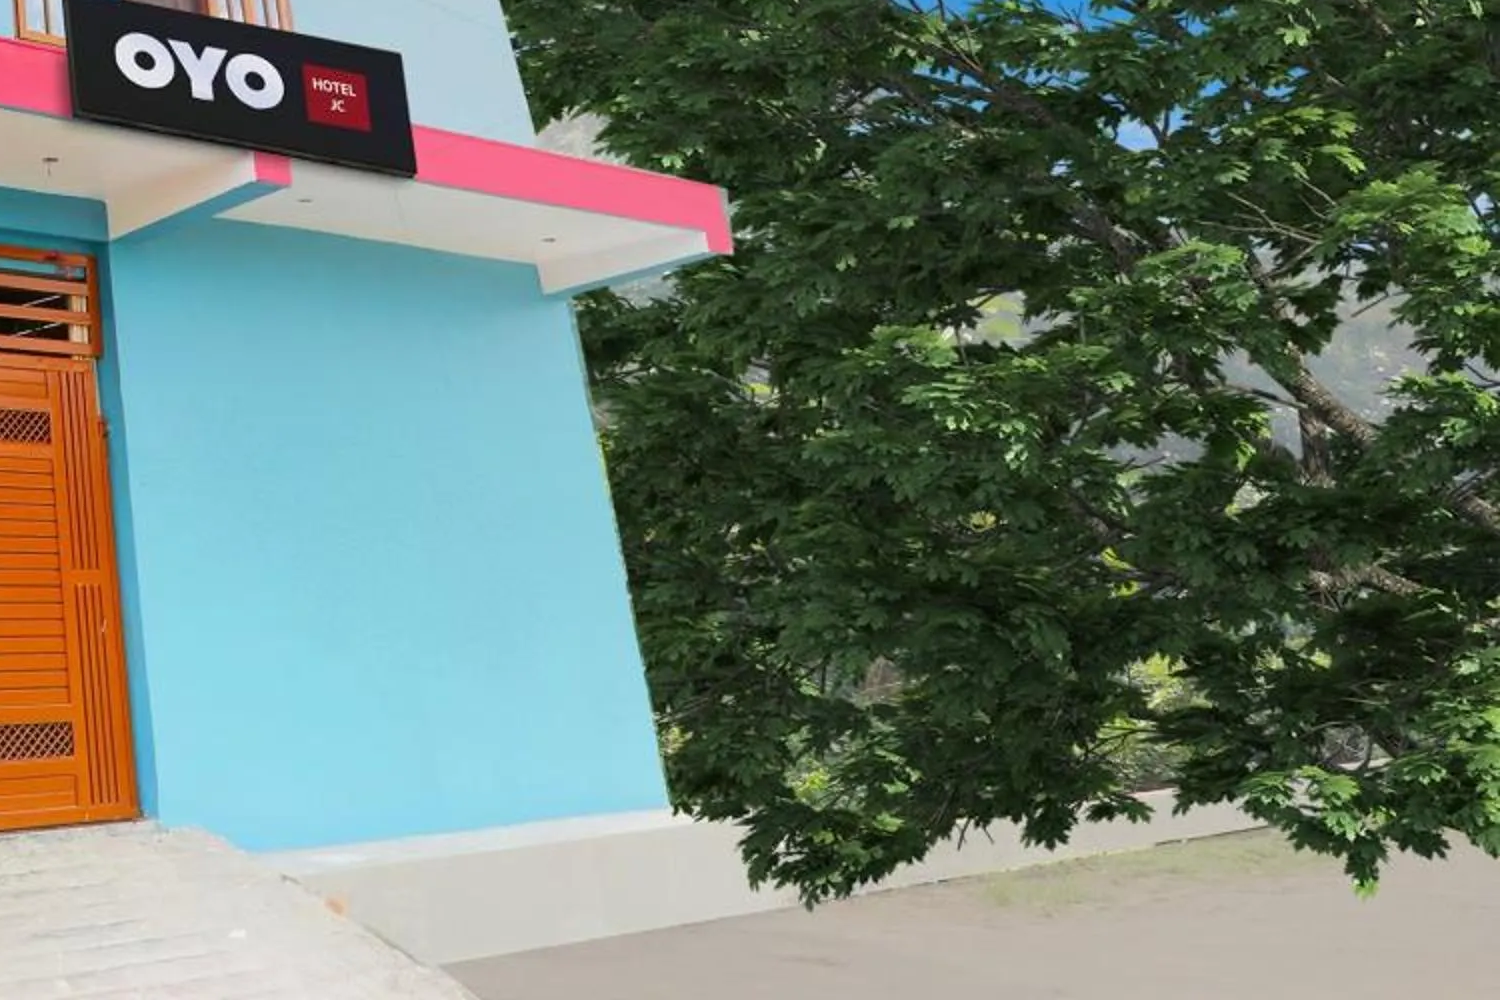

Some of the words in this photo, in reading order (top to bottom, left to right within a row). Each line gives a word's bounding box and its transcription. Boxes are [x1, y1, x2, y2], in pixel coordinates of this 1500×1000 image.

[114, 32, 285, 110] OYO
[311, 77, 357, 97] HOTEL
[330, 99, 346, 113] JC
